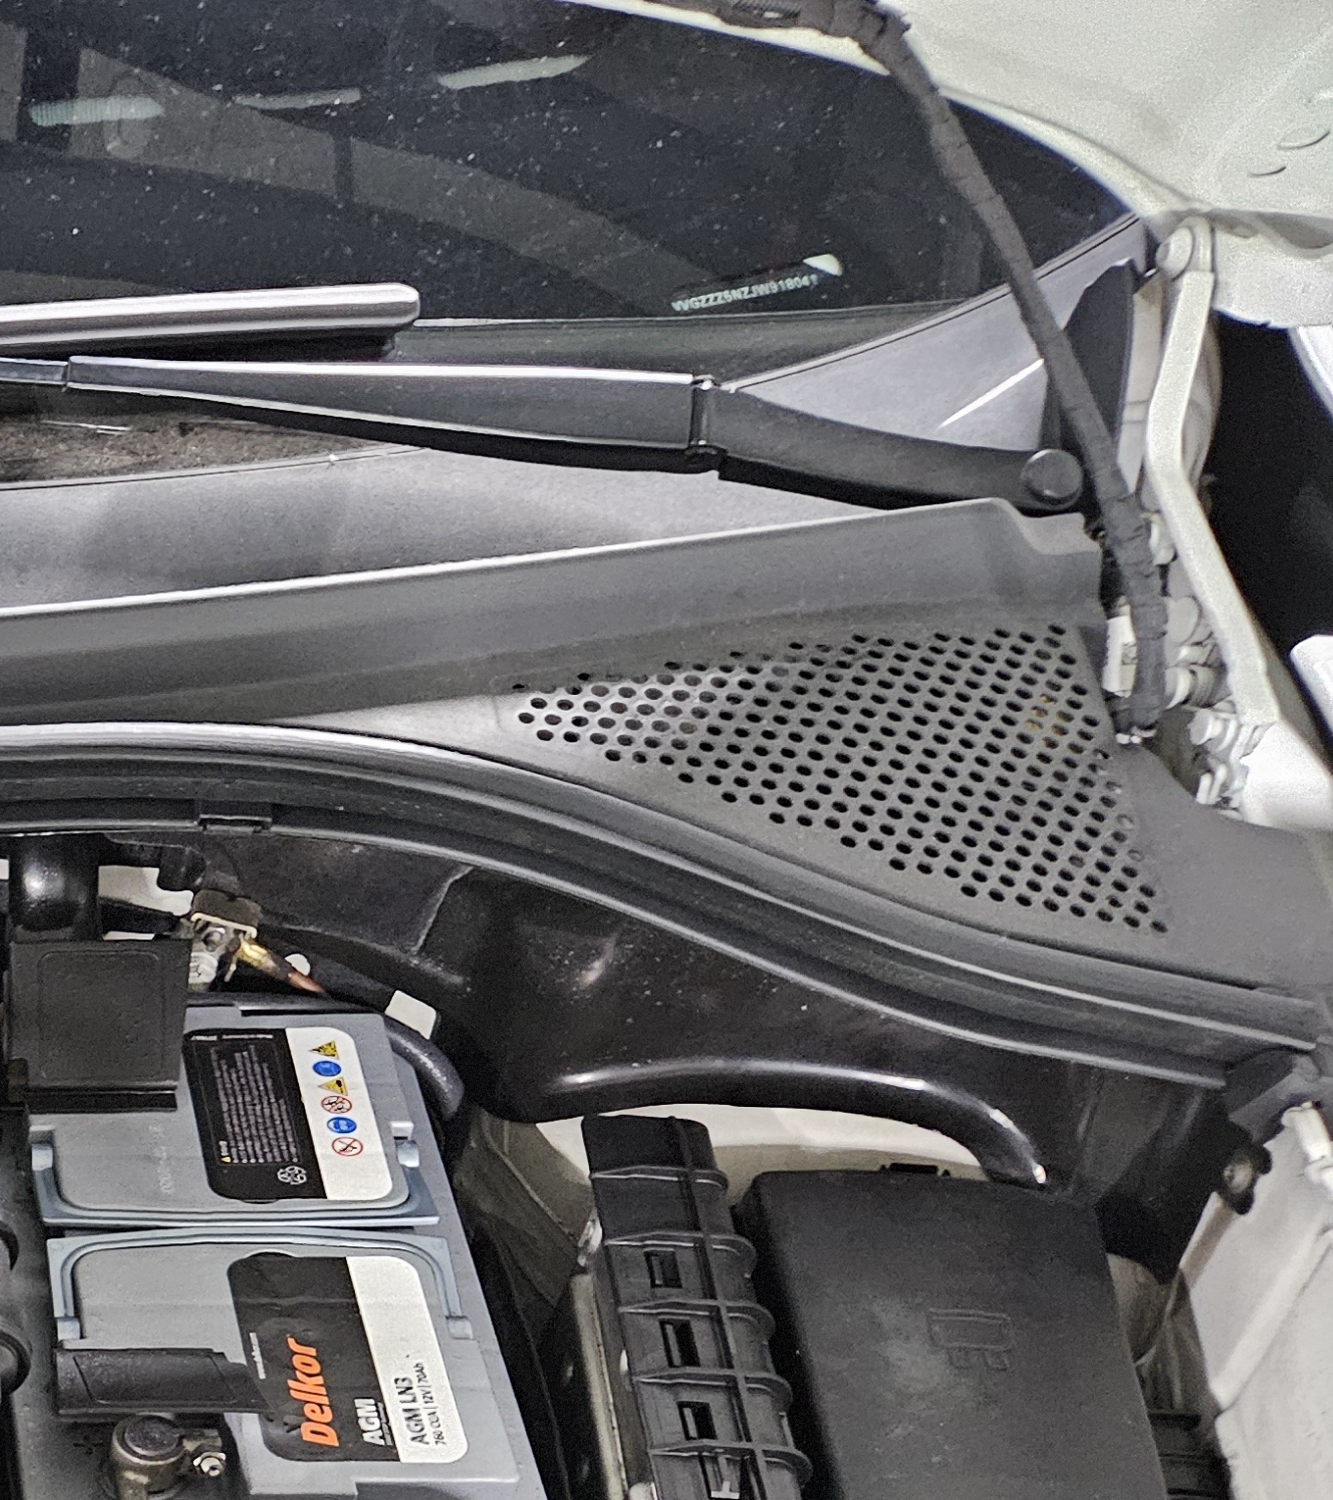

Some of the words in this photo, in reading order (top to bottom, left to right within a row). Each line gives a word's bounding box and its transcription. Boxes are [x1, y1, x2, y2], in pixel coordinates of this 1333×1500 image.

[287, 1334, 339, 1447] Delkor
[393, 1376, 418, 1404] LN3
[420, 1389, 435, 1405] 12V
[354, 1398, 385, 1446] AGM
[401, 1407, 430, 1446] AGM
